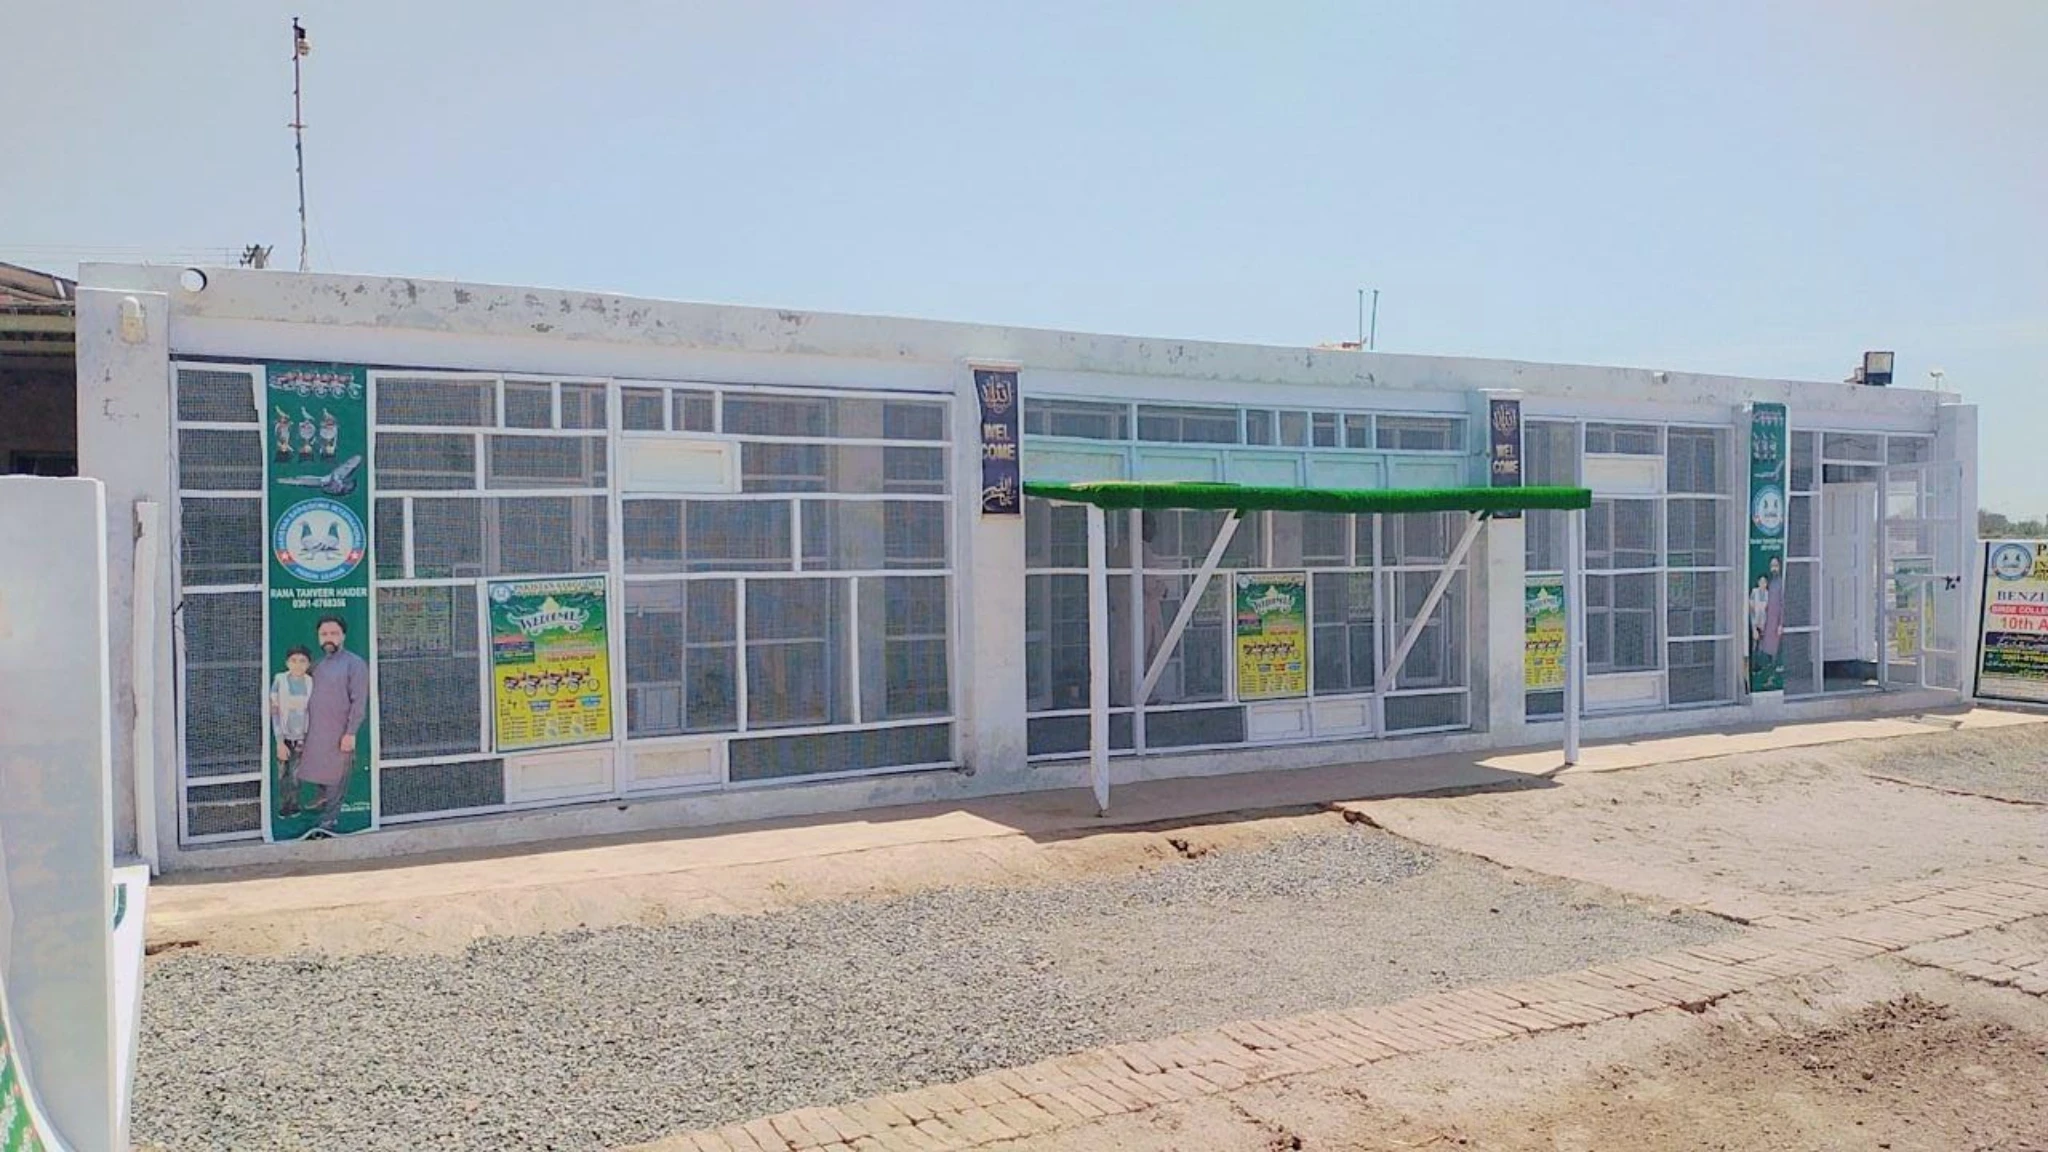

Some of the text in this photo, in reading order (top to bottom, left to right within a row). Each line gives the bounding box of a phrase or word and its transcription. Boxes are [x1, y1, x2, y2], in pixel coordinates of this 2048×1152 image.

[983, 423, 1009, 440] WEL
[982, 443, 1016, 460] COME
[2002, 617, 2033, 629] 10th
